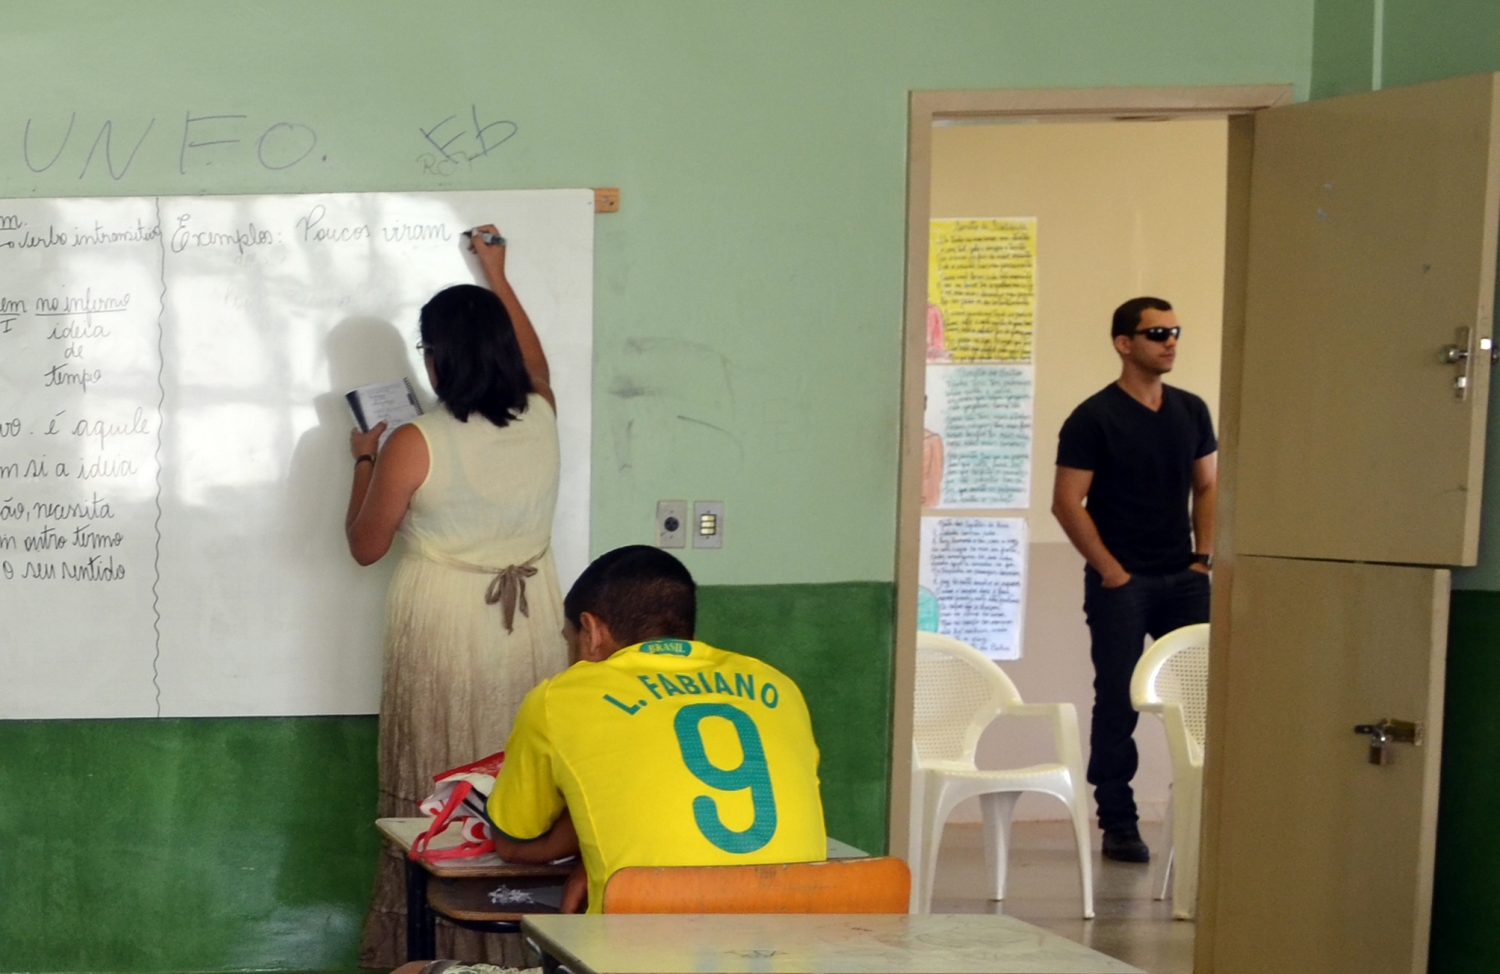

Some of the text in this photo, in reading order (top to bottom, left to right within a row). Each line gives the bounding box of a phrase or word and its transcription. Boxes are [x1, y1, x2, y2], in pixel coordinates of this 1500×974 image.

[295, 205, 371, 244] Poucos
[382, 219, 452, 244] viram
[34, 295, 59, 313] no
[47, 317, 111, 340] ideia
[64, 341, 84, 359] de
[44, 363, 102, 393] tempo
[45, 409, 67, 436] é
[71, 407, 151, 450] aquele
[24, 455, 48, 480] si
[56, 463, 70, 478] a
[32, 492, 116, 521] necessita
[24, 525, 68, 553] outro
[71, 524, 124, 548] termo
[2, 561, 14, 581] o
[21, 562, 57, 580] seu
[61, 555, 127, 583] sentido
[648, 641, 687, 655] BRASIL
[603, 671, 779, 716] L. FABIANO
[673, 702, 778, 854] 9
